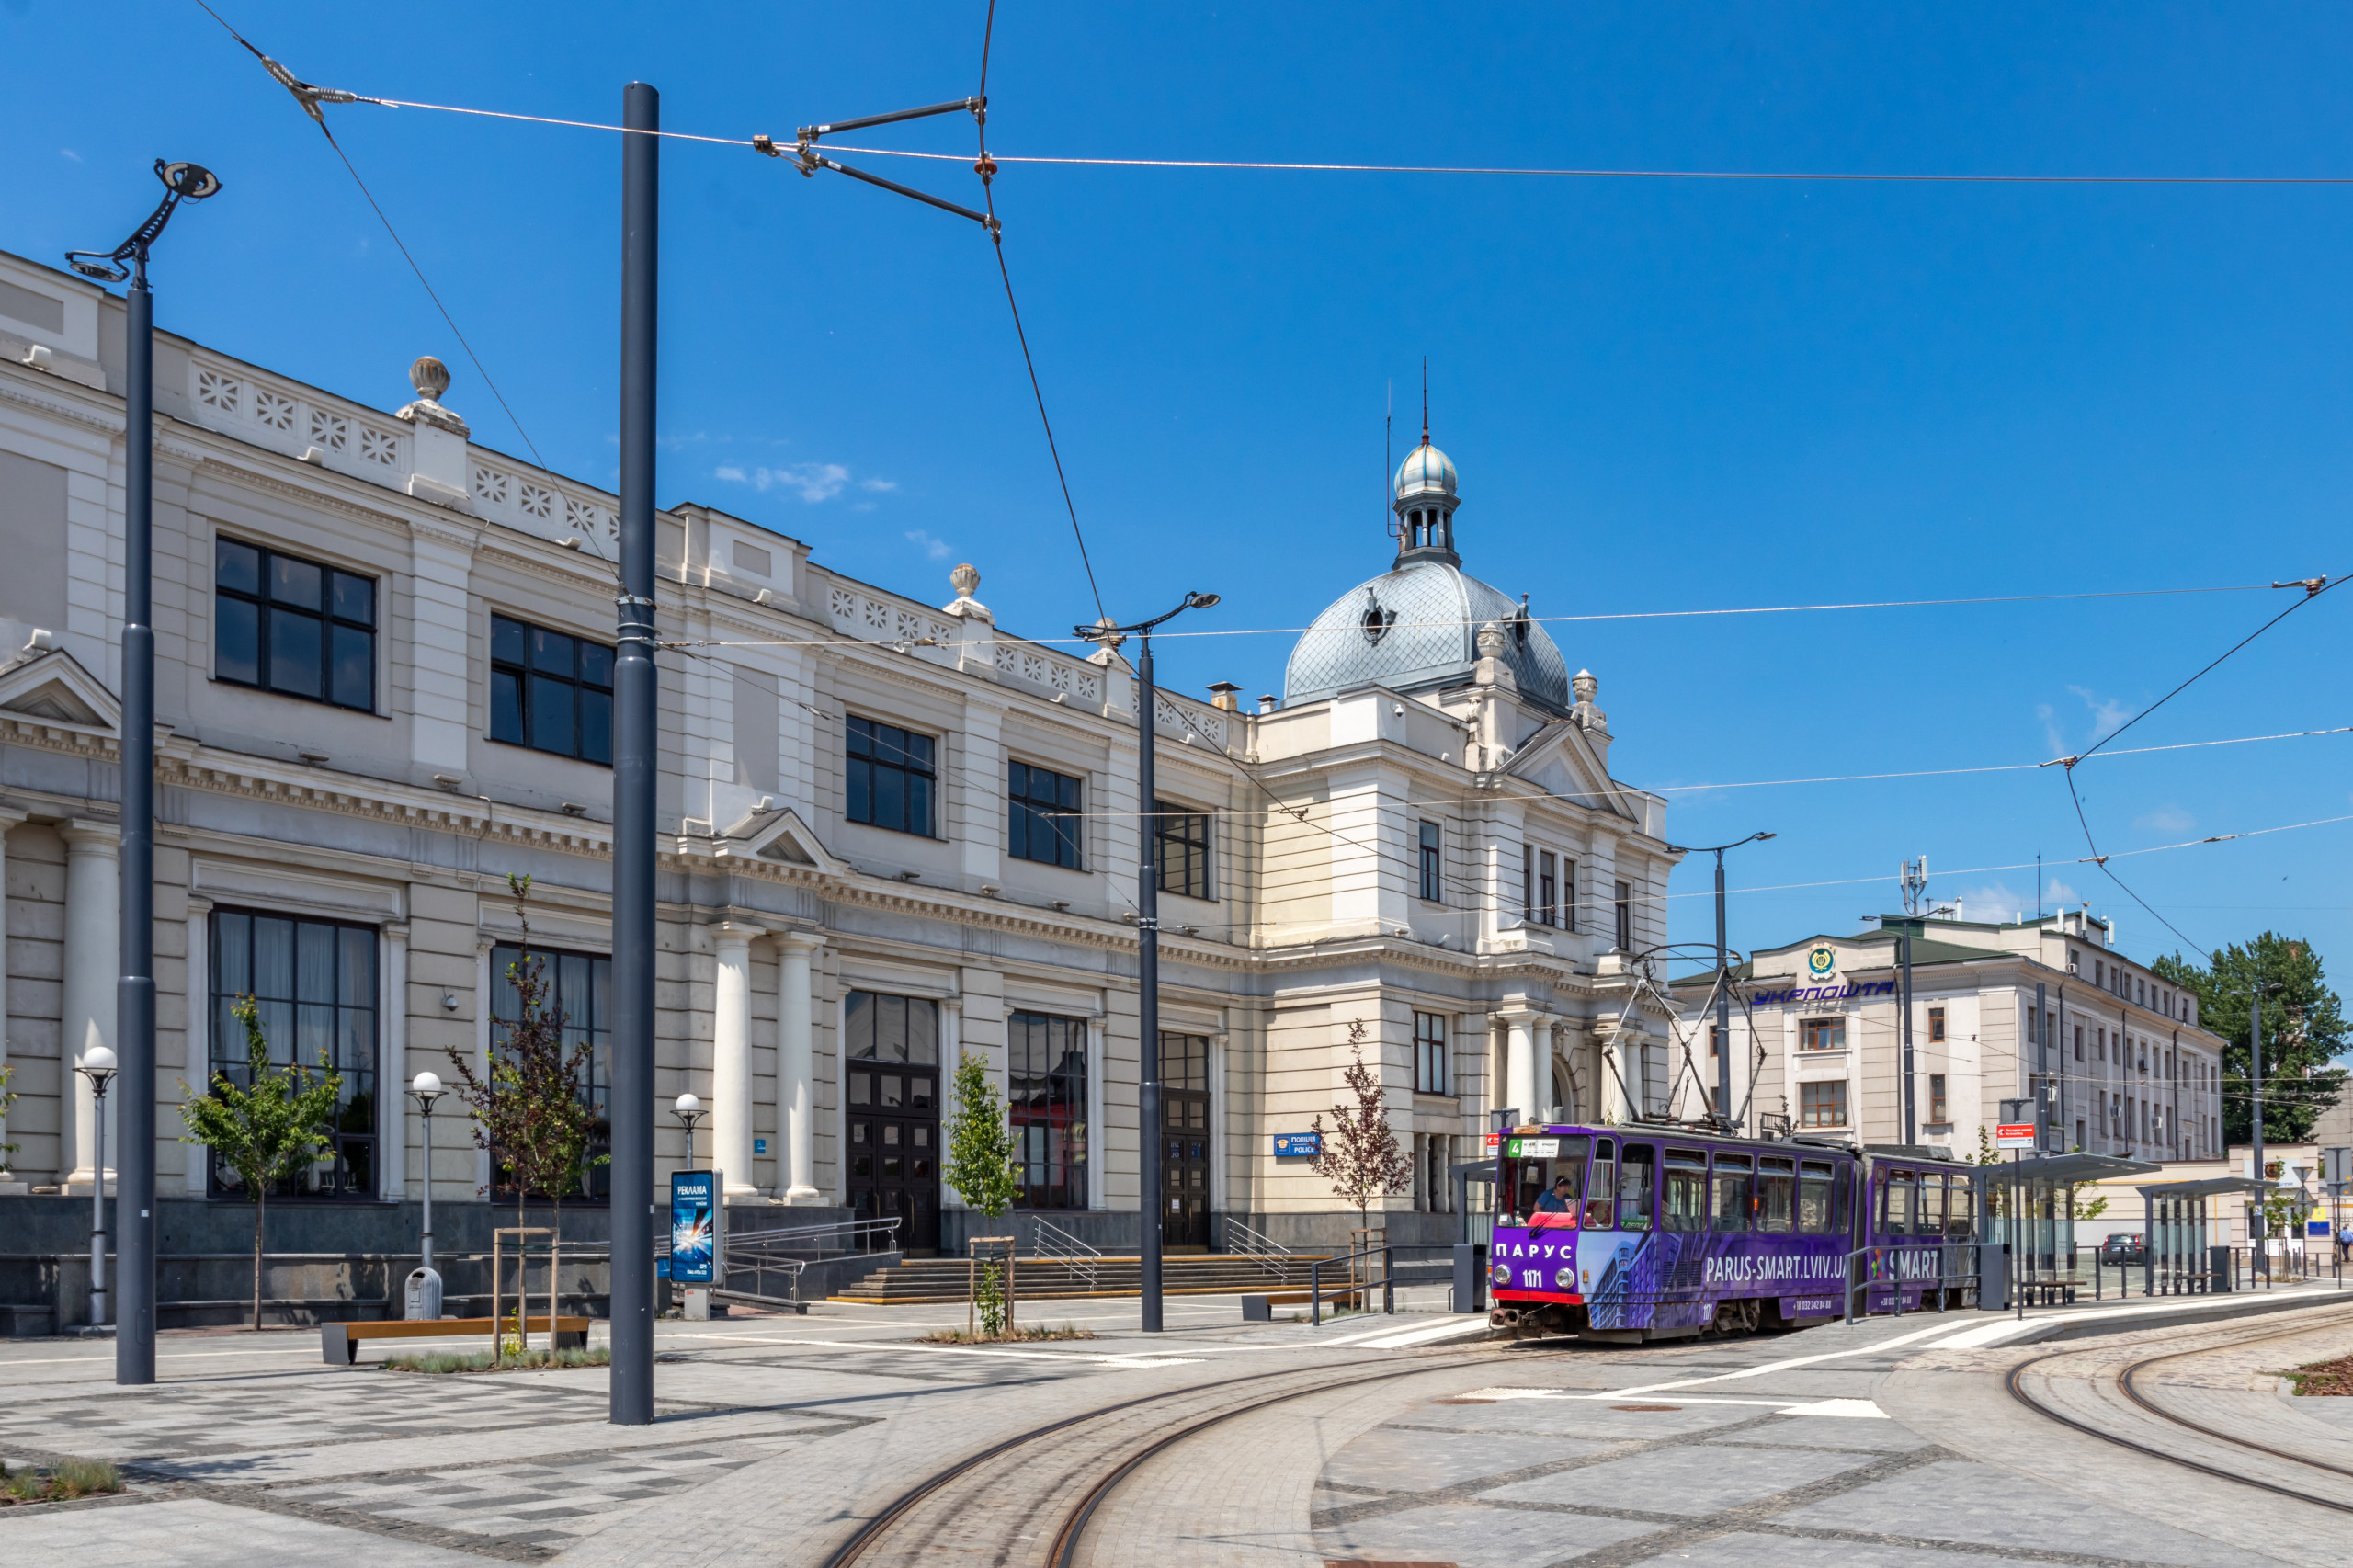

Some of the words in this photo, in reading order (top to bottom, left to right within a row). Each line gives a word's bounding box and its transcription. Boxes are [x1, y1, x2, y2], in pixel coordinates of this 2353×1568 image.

[1752, 981, 1894, 1006] УКРПОШТА
[1511, 1142, 1519, 1153] 4
[677, 1186, 707, 1195] РЕКЛАМА
[1495, 1243, 1572, 1259] ПАРУС
[1522, 1269, 1542, 1288] 1171
